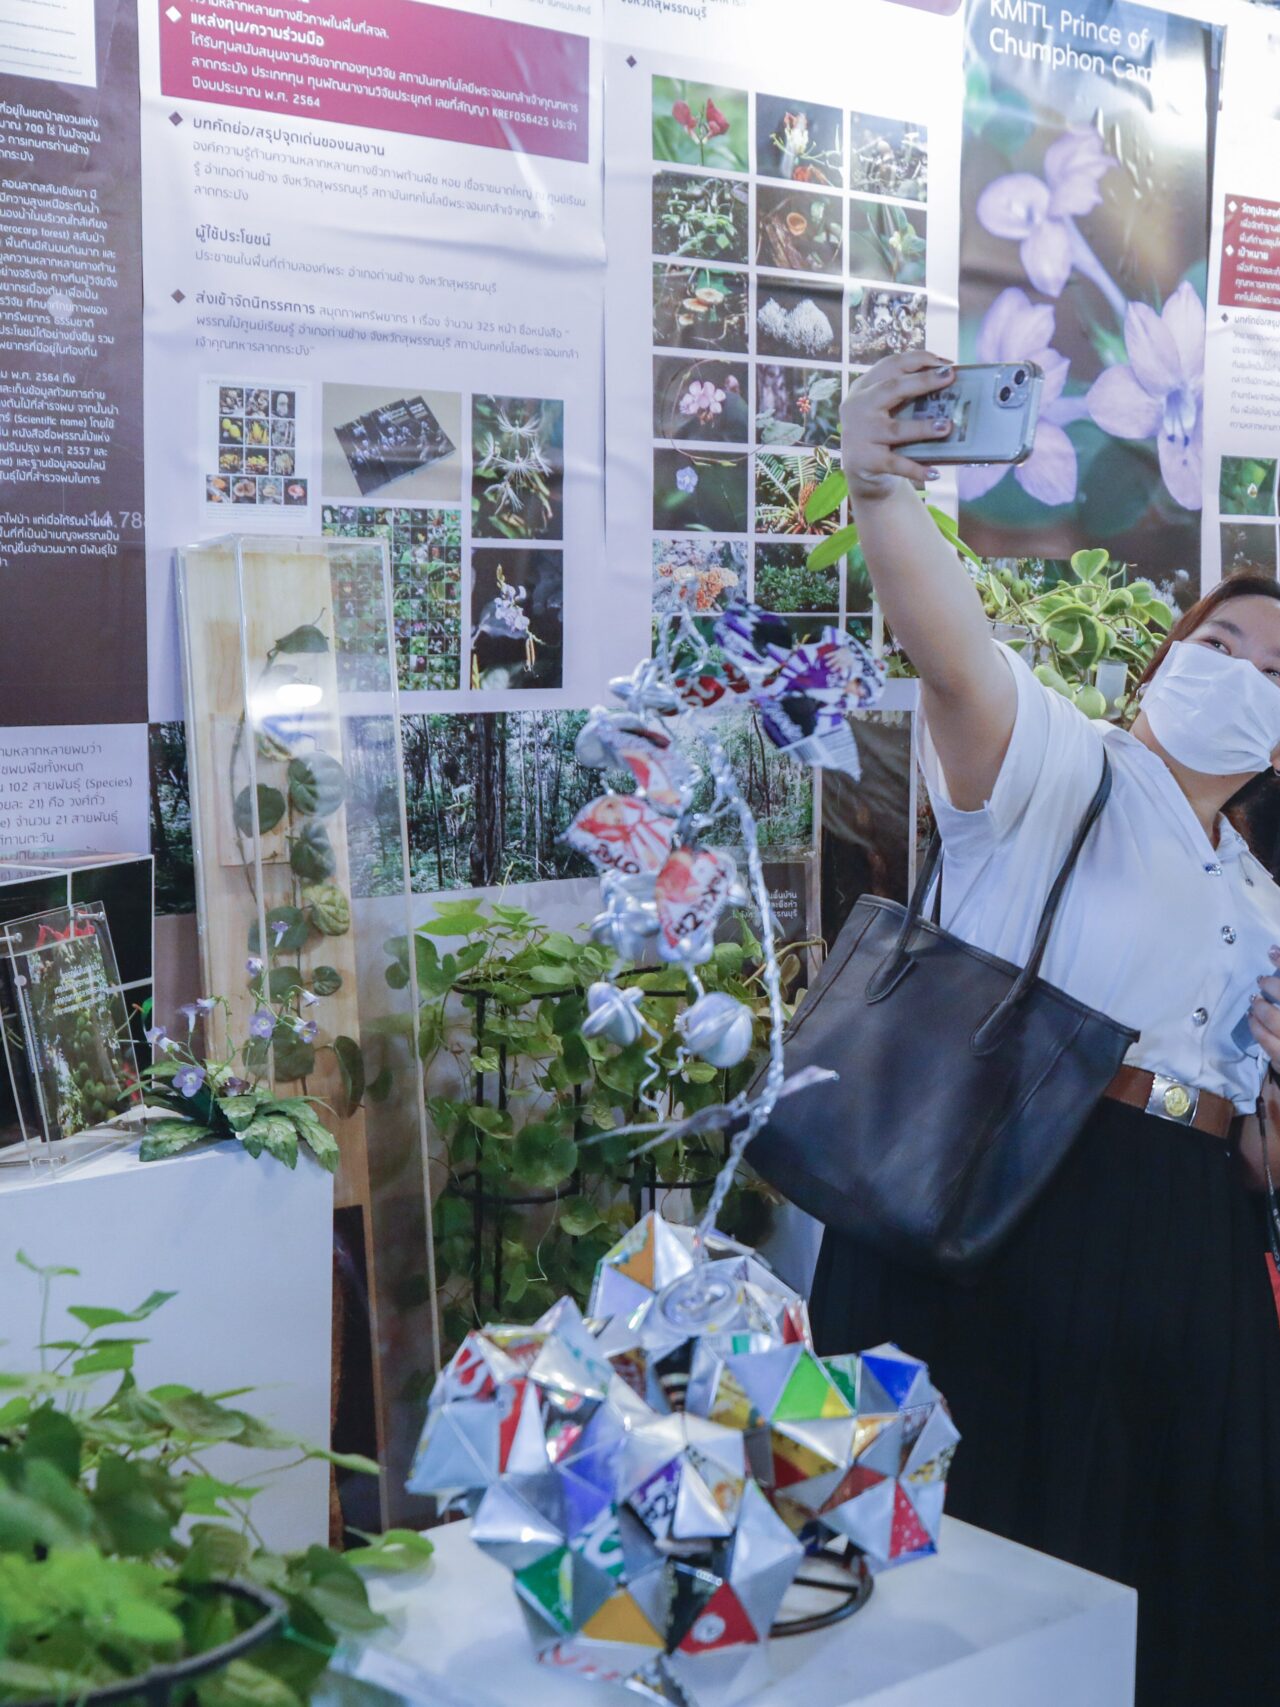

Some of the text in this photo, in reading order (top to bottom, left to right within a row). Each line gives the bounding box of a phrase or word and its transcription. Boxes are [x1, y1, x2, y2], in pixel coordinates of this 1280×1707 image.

[190, 0, 389, 39] ามหลากหลายทางชีวภาพในพื้นที่สจล.
[620, 0, 707, 20] จงหวดสุพรรณบุรี
[191, 12, 324, 47] แหล่งทุน/ความร่วมมือ
[990, 0, 1148, 50] KMITL Prince of
[989, 27, 1104, 74] Chumphon
[191, 31, 579, 113] ได้รับทุนสนับสนุนงานวิจัยจากกองทุนวิจัย สถาบันเทคโนโลยีพระจอมเกล้าเจ้าคุณทหาร
[191, 55, 248, 76] ลาดกระบัง
[252, 65, 303, 87] ประเภททุน
[307, 76, 432, 108] ทุนพัฒนางานวิจัยประยุกต์
[435, 95, 489, 117] เลขที่สัญญา
[552, 118, 577, 132] ประจำ
[192, 75, 261, 98] ปีงบประมาณ
[293, 93, 320, 108] 2564
[25, 122, 43, 133] 700
[46, 123, 56, 136] ไร่
[58, 125, 100, 144] ในปัจจุบัน
[193, 117, 385, 156] บทคัดย่อ/สรุปจุดเด่นของผลงาน
[8, 135, 89, 155] การเกษตรด่านช้าง
[193, 184, 249, 201] ลาดกระบัง
[204, 162, 278, 184] อำเภอด่านช้าง
[282, 173, 368, 198] จังหวัดสุพรรณบุรี
[371, 186, 556, 223] สถาบันเทคโนโลยีพระจอมเกล้าเจ้าคุณทร
[441, 177, 461, 189] หอย
[42, 227, 70, 240] forest)
[73, 231, 105, 243] สลับป่า
[195, 224, 271, 247] ผู้ใช้ประโยชน์
[103, 250, 116, 258] และ
[195, 249, 344, 276] ประชาชนในพื้นที่ตำบลองค์พระ
[418, 273, 497, 295] จังหวัดสุพรรณบุรี
[54, 317, 94, 328] ธรรมชาติ
[195, 290, 316, 315] ส่งเข้าจัดนิทรรศการ
[319, 305, 408, 324] สมุดภาพทรัพยากร
[419, 313, 440, 327] เรื่อง
[444, 315, 473, 330] จำนวน
[476, 321, 495, 332] 325
[498, 323, 517, 335] หน้า
[98, 334, 114, 344] รวม
[196, 315, 294, 338] พรรณไม้ศูนย์เรียนรู้
[370, 330, 450, 352] จังหวัดสุพรรณบุรี
[12, 371, 31, 380] พ.ศ.
[36, 372, 60, 382] 2564
[63, 372, 76, 384] ถึง
[78, 401, 119, 415] จากนั้นนำ
[14, 414, 56, 425] (Scientific
[60, 417, 87, 428] name)
[90, 416, 114, 429] โดยใช้
[44, 446, 63, 455] พ.ศ.
[67, 446, 91, 456] 2557
[94, 448, 108, 457] และ
[10, 782, 28, 792] 102
[33, 779, 81, 793] สายพันธุ์
[86, 777, 133, 790] (Species)
[48, 797, 65, 808] คือ
[70, 793, 105, 807] วงศ์ถั่ว
[17, 814, 51, 828] จำนวน
[55, 814, 67, 825] 21
[72, 810, 119, 825] สายพันธุ์
